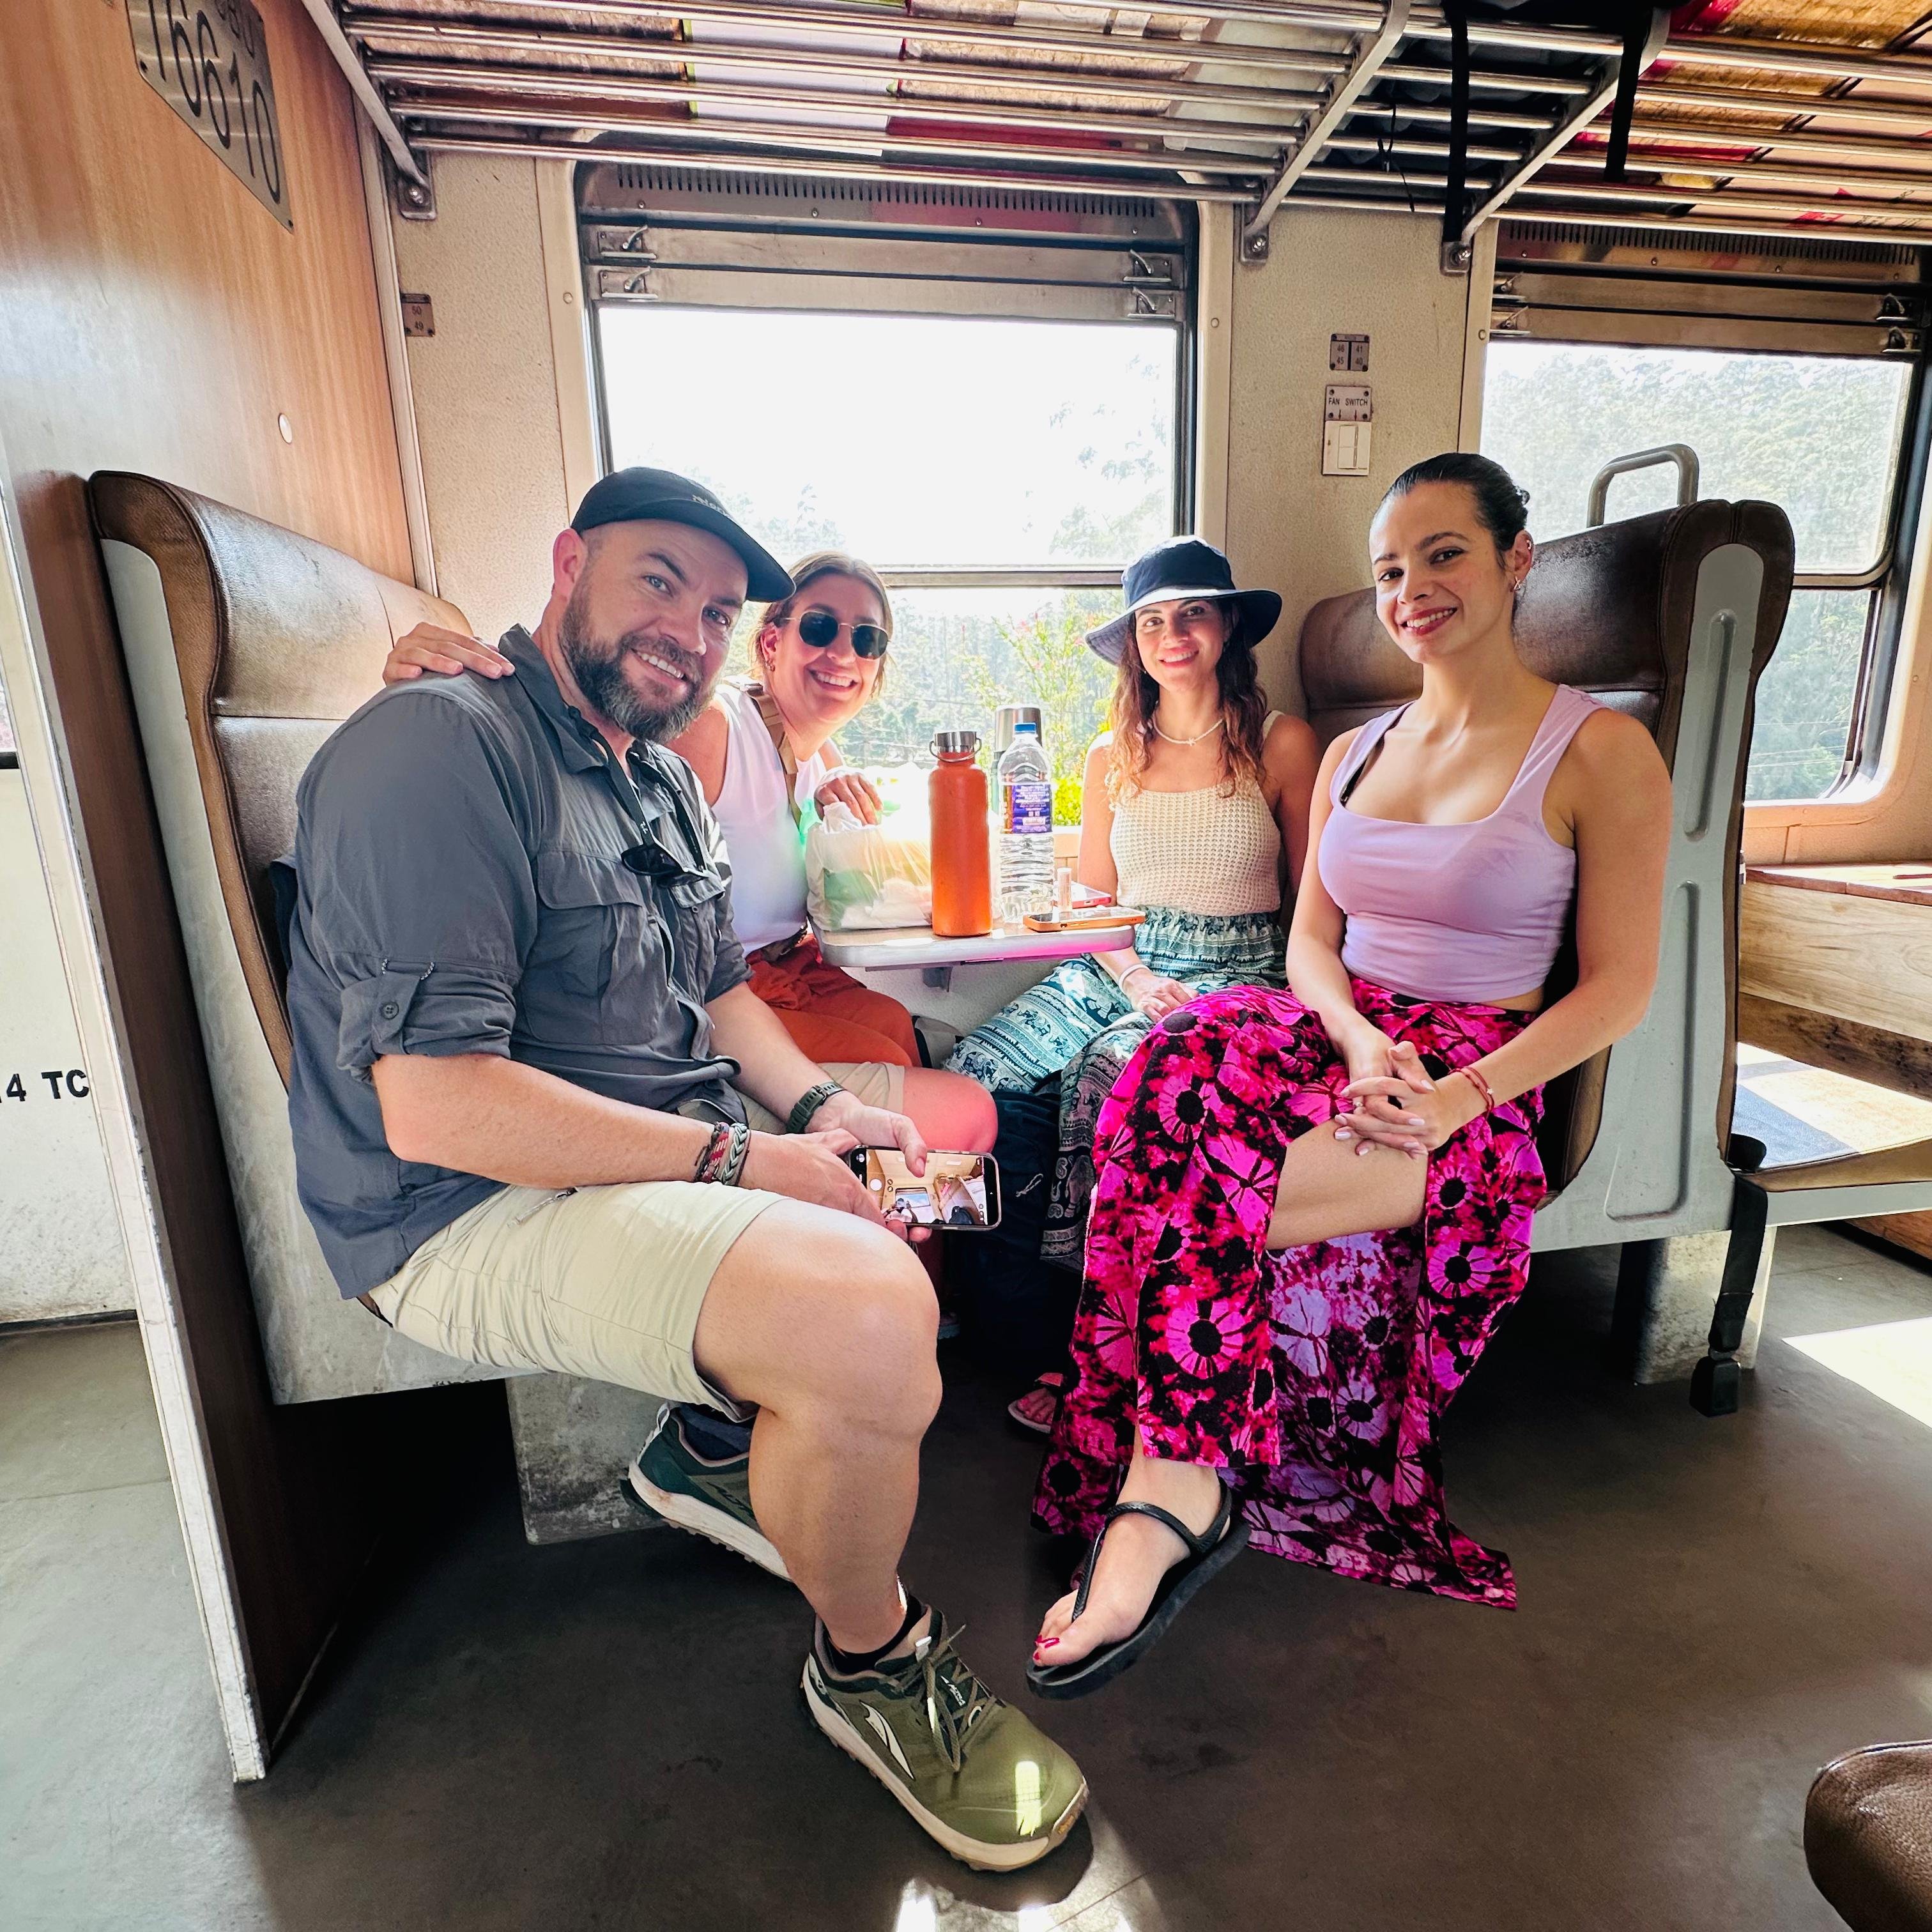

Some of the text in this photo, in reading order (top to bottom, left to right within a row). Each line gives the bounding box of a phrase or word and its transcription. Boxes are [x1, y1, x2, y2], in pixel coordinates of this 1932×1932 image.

[148, 0, 280, 204] 16610
[1328, 397, 1368, 406] FAN SWITCH
[0, 1069, 89, 1103] 4 TC
